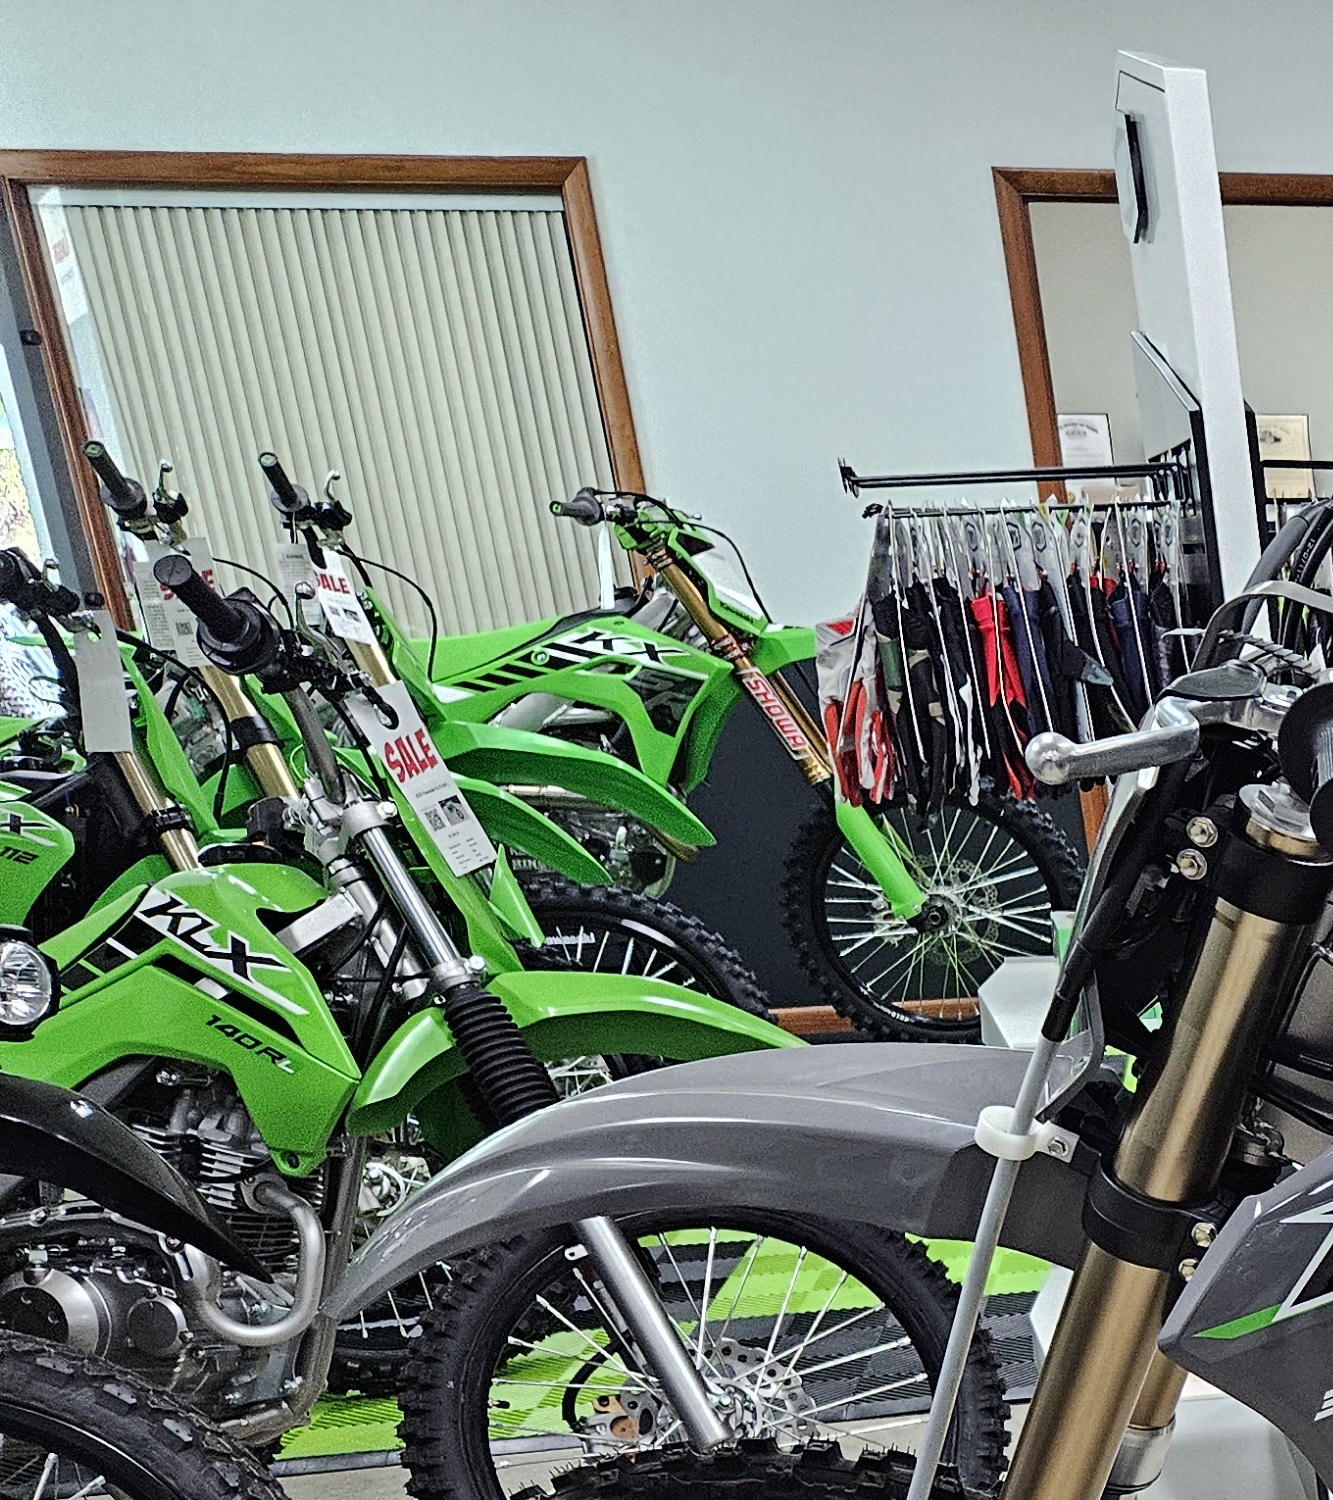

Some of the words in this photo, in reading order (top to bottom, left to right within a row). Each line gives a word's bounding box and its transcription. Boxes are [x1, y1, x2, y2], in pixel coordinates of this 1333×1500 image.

[570, 628, 691, 666] KX
[748, 678, 807, 748] SHOWA
[383, 728, 439, 784] SALE
[136, 890, 292, 985] KLX
